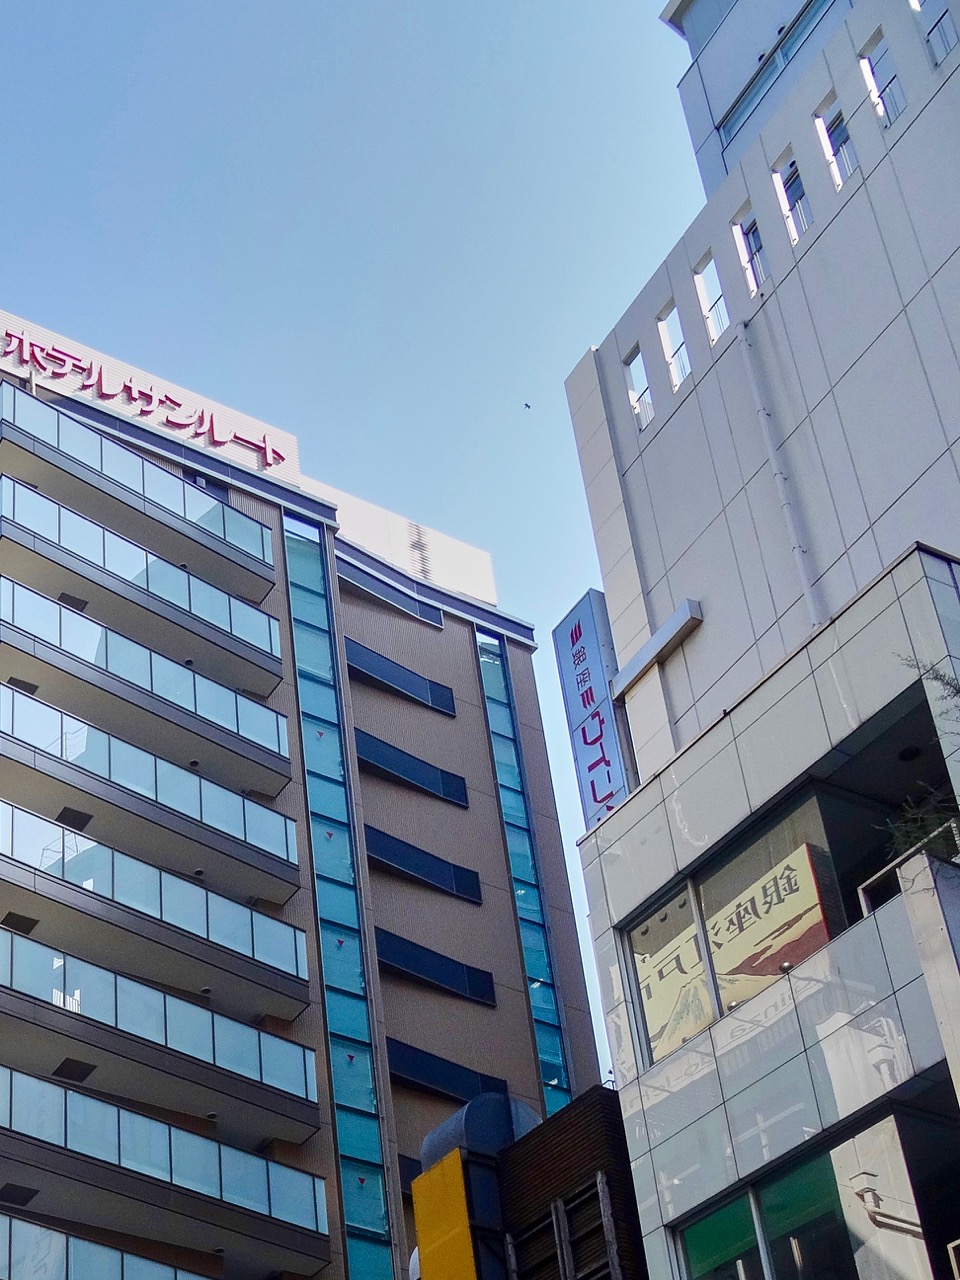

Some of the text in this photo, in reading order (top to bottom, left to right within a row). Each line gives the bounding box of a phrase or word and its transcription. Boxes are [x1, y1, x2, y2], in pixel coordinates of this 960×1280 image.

[4, 327, 287, 468] ホテルサンルート
[571, 645, 615, 823] 銀座 ウイン
